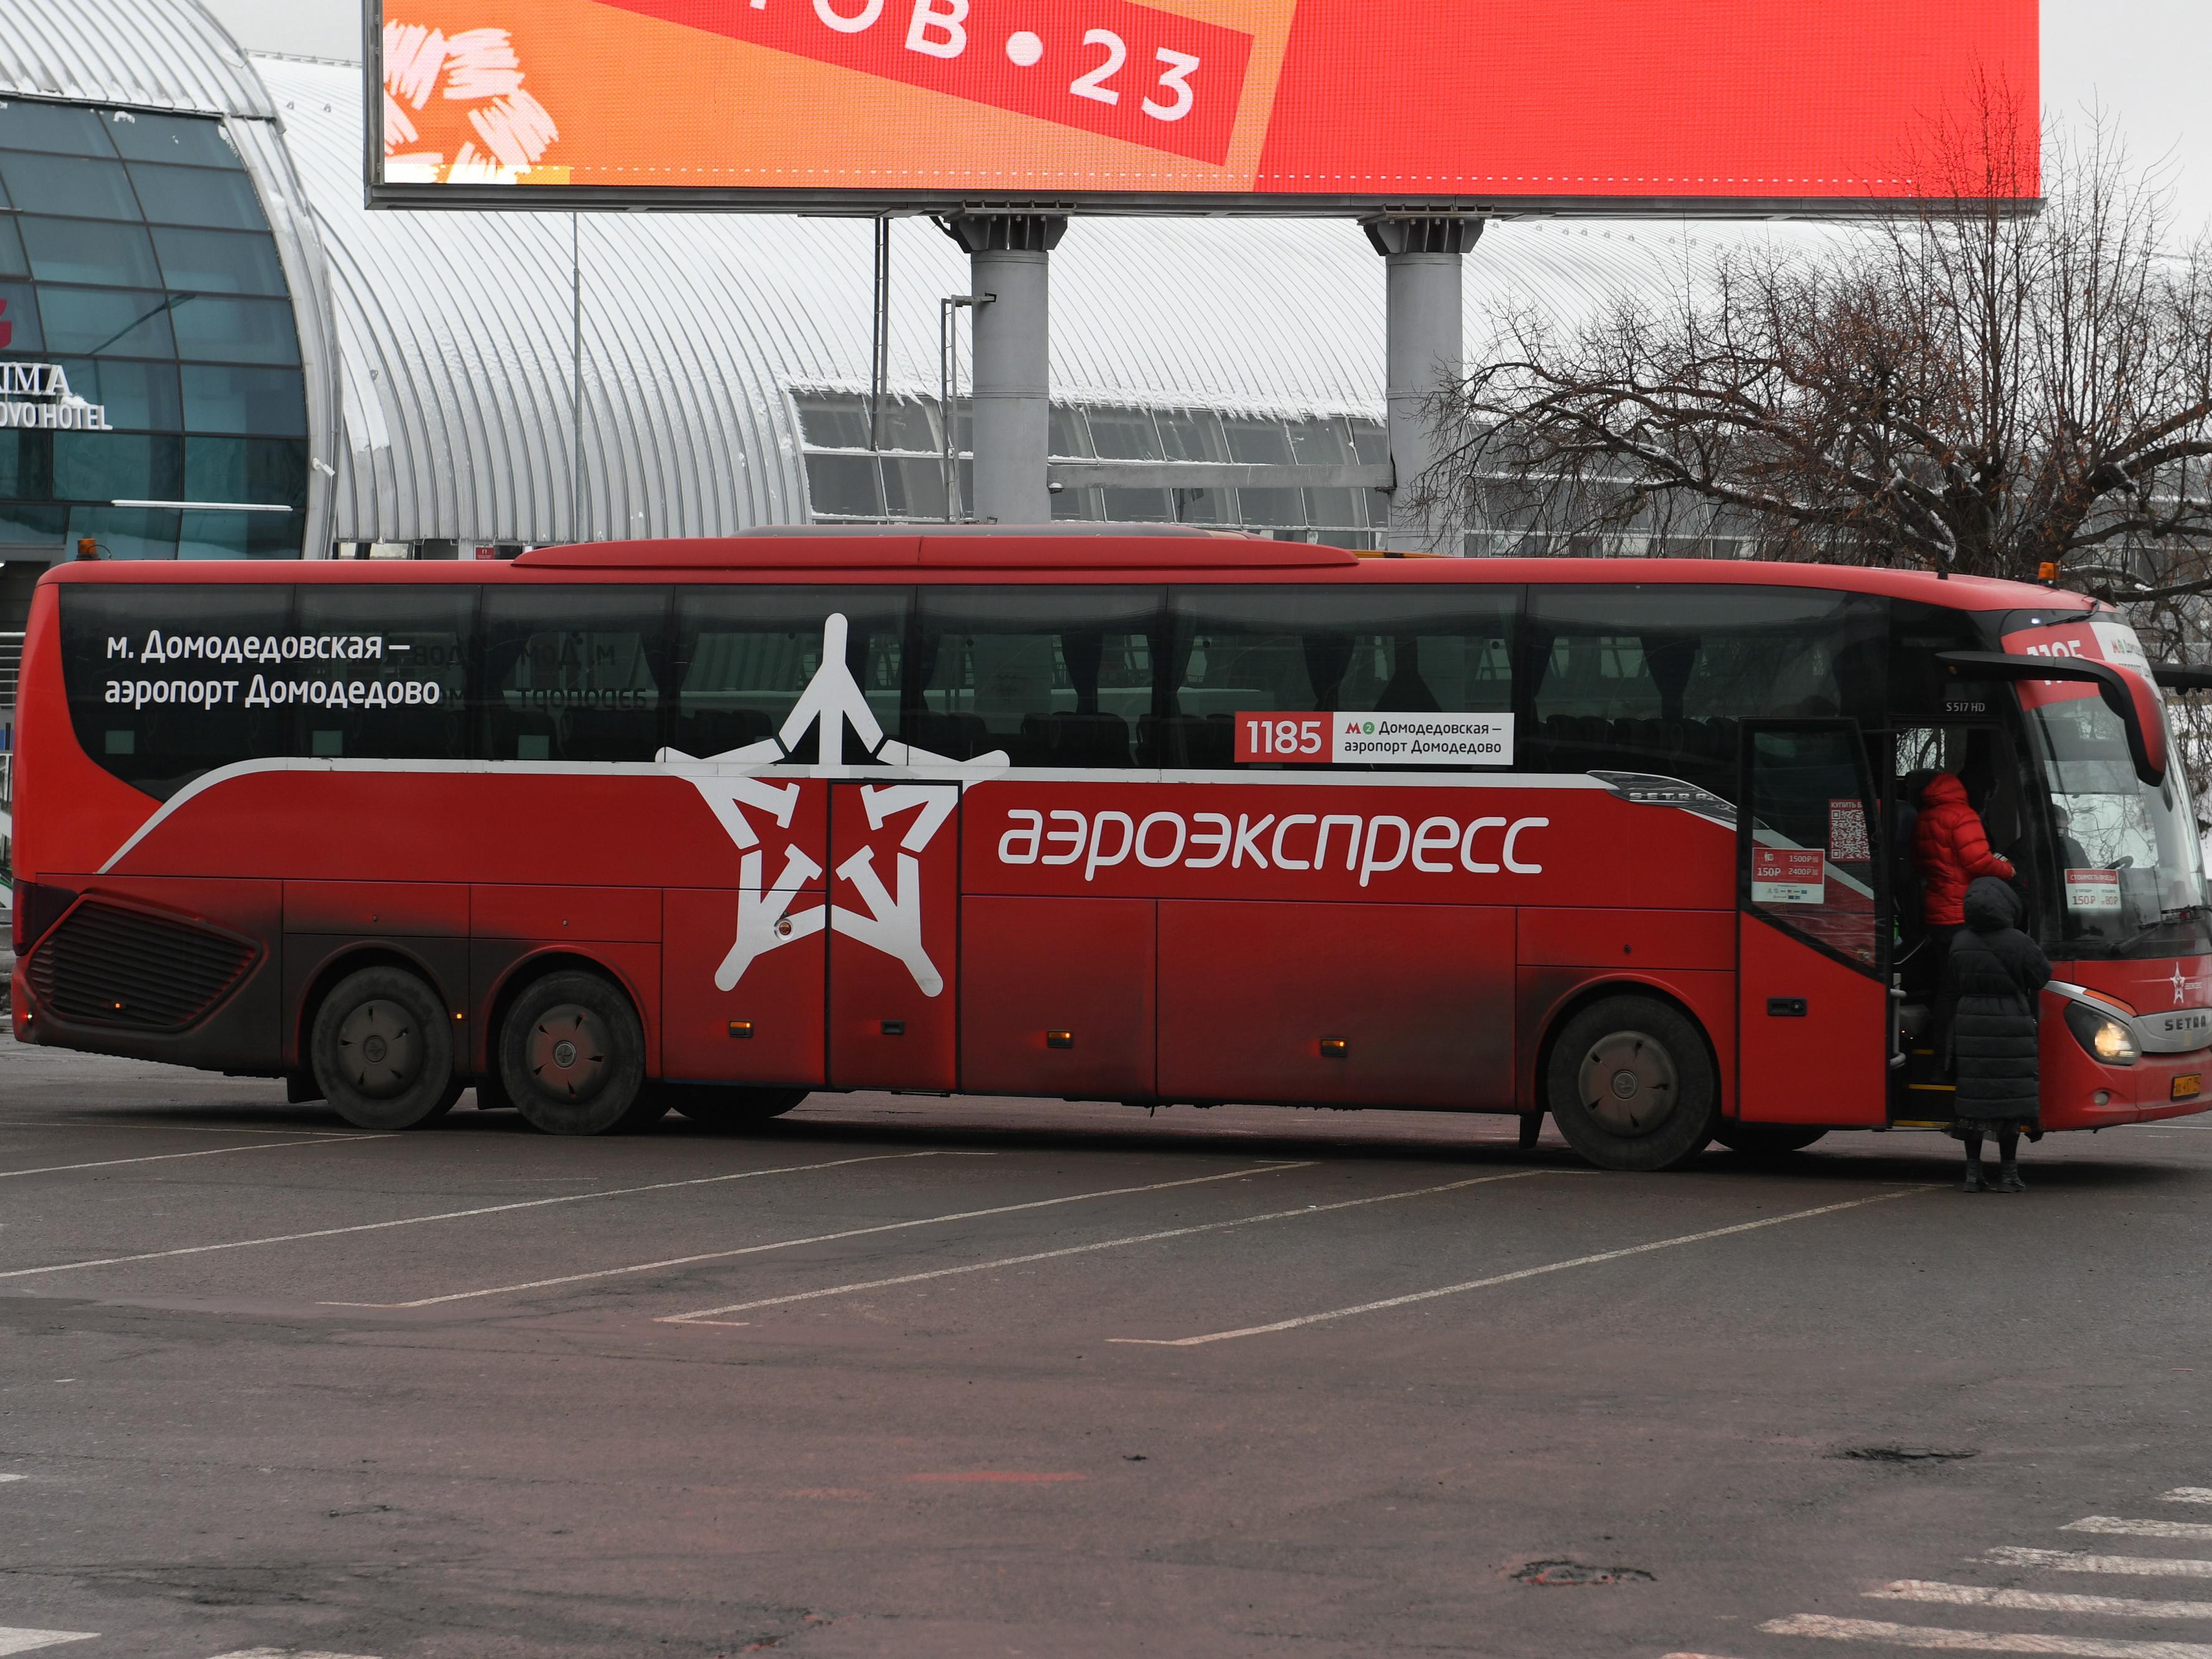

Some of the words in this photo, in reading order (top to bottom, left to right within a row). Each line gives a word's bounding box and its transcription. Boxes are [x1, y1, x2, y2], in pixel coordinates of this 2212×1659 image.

[1069, 28, 1200, 121] 23
[0, 362, 73, 396] IMA
[39, 402, 113, 430] HOTEL
[107, 636, 134, 659] м.
[141, 630, 382, 663] Домодедовская
[105, 680, 239, 710] аэропорт
[245, 674, 440, 709] Домодедово
[1971, 702, 1985, 712] HD
[1246, 720, 1322, 754] 1185
[1379, 721, 1489, 735] Домодедовская
[1345, 741, 1407, 755] аэропорт
[1411, 740, 1501, 755] Домодедово
[1629, 792, 1707, 800] SETRA
[998, 808, 1549, 887] аэроэкспресс
[2165, 1015, 2206, 1031] SETRA
